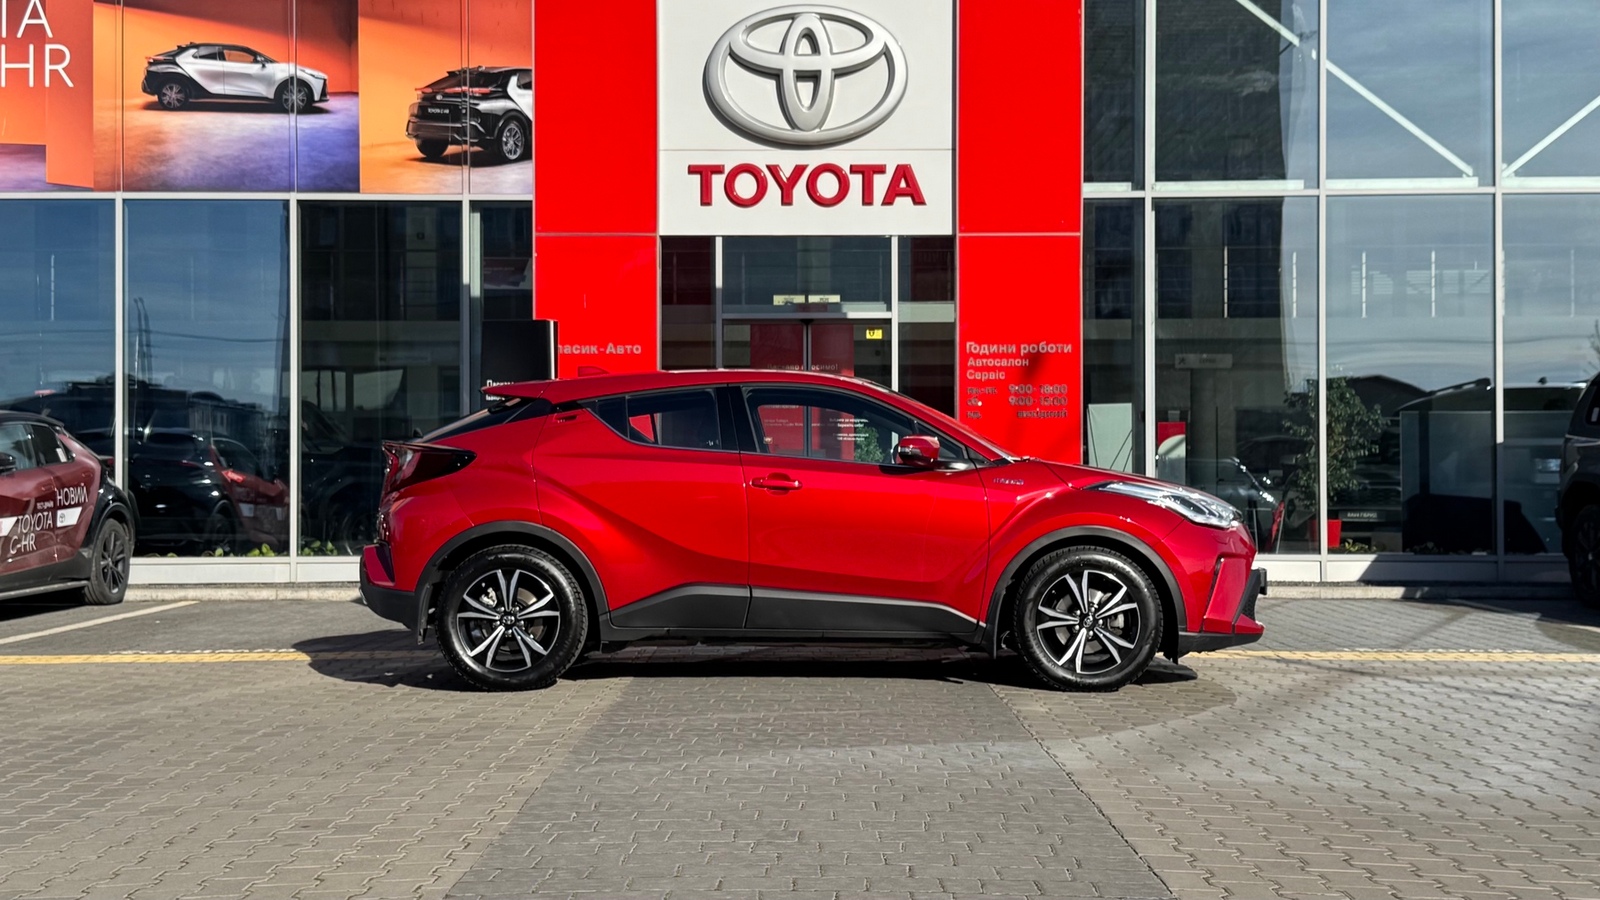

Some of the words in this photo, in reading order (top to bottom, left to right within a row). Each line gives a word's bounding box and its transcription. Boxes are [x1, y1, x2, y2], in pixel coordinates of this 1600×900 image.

[687, 162, 927, 208] TOYOTA
[966, 342, 1016, 355] Години
[1020, 341, 1072, 356] роботи
[967, 357, 1029, 367] Автосалон
[966, 369, 1006, 382] Сервіс
[56, 482, 89, 507] НОВИЙ
[17, 511, 54, 534] TOYOTA
[9, 533, 37, 555] C-HR
